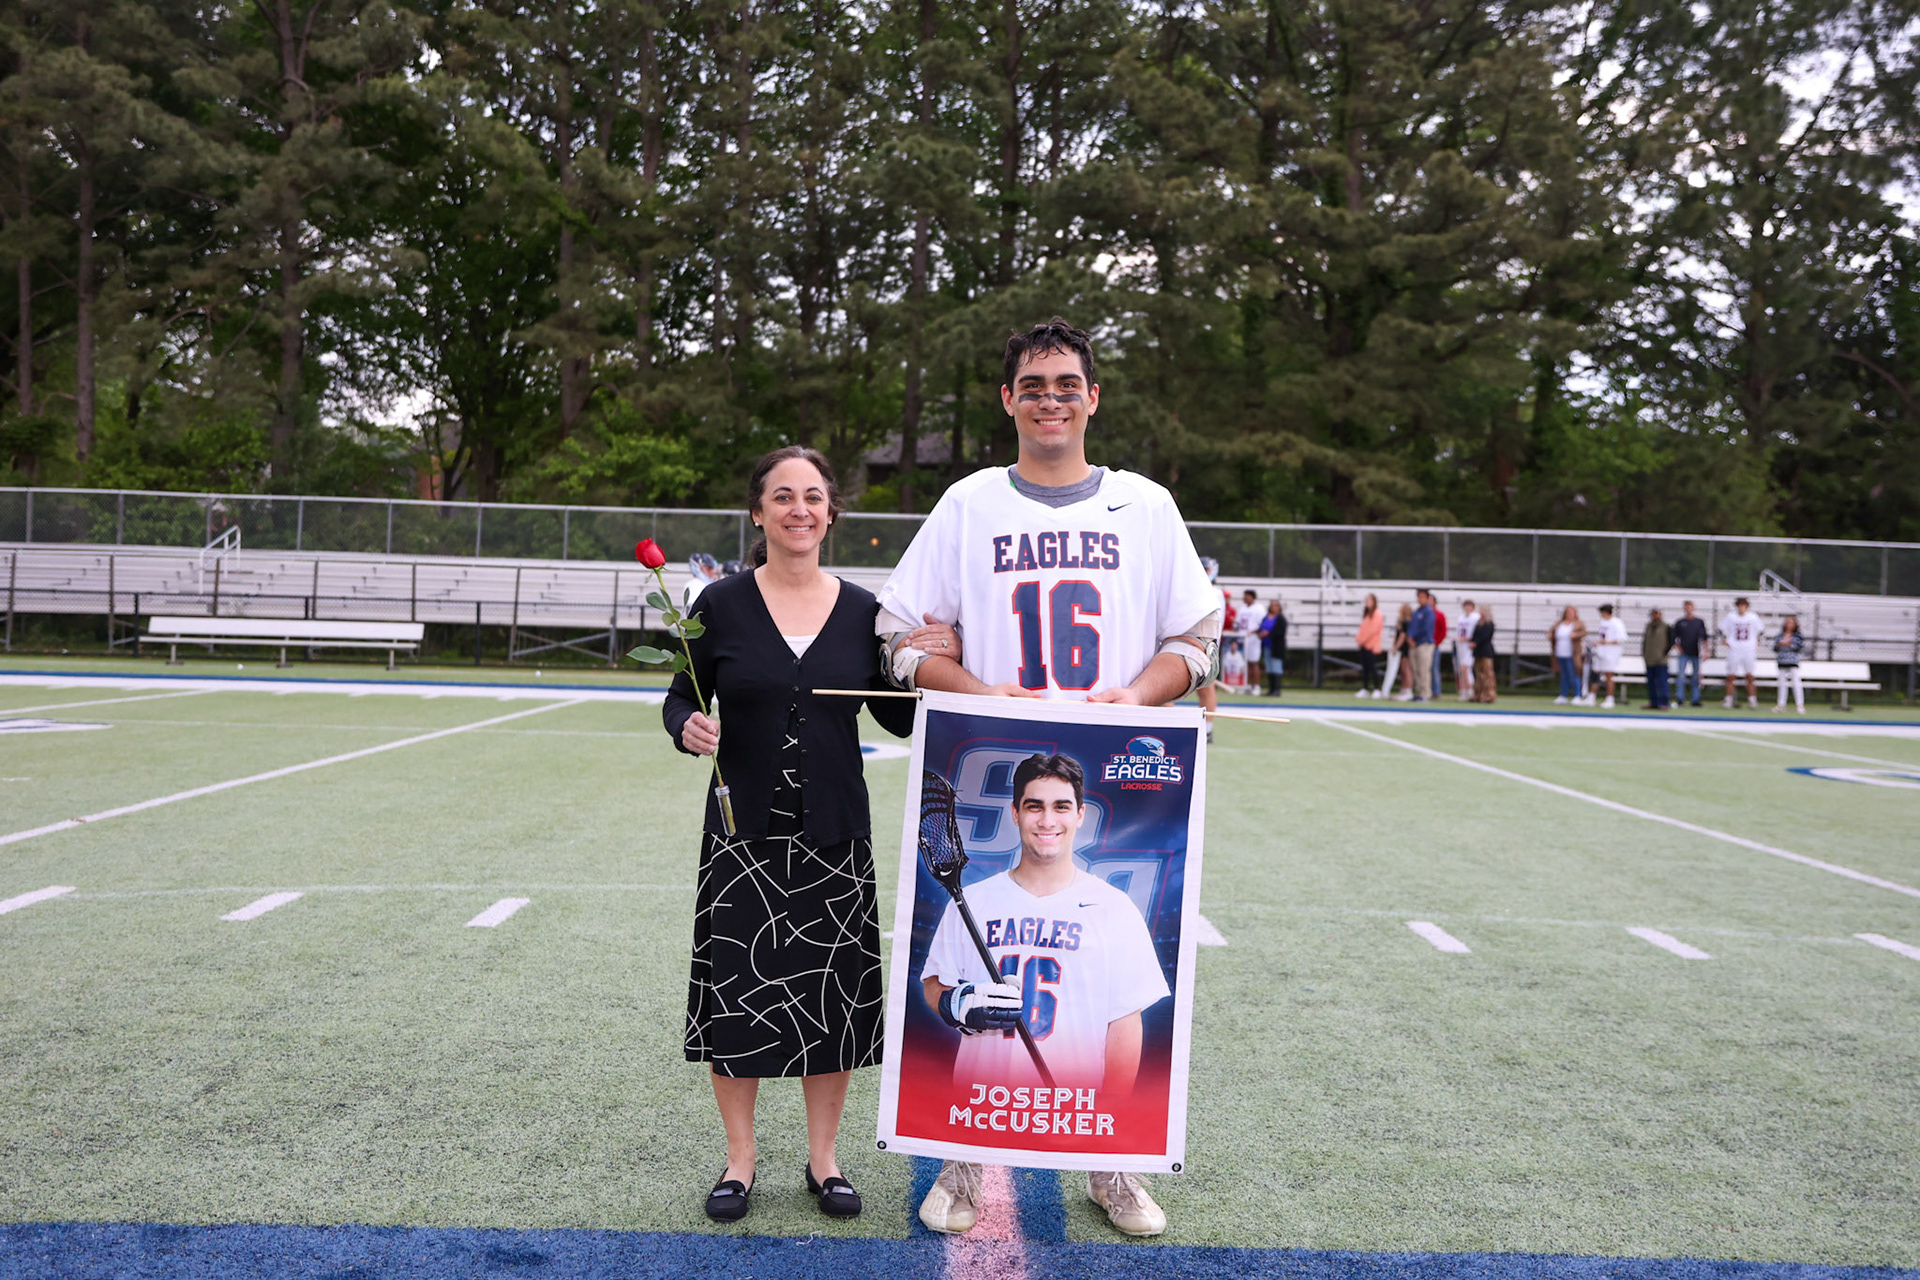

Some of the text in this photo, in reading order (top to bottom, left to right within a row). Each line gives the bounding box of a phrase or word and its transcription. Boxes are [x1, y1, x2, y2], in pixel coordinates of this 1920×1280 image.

[993, 531, 1120, 573] EAGLES
[1012, 580, 1102, 690] 16
[1105, 764, 1181, 781] EAGLES
[1113, 755, 1176, 765] ST. BENEDICT
[1121, 783, 1162, 791] LACROSSE
[986, 917, 1083, 951] EAGLES
[969, 1083, 1097, 1111] JOSEPH
[948, 1104, 1115, 1136] McCUSKER
